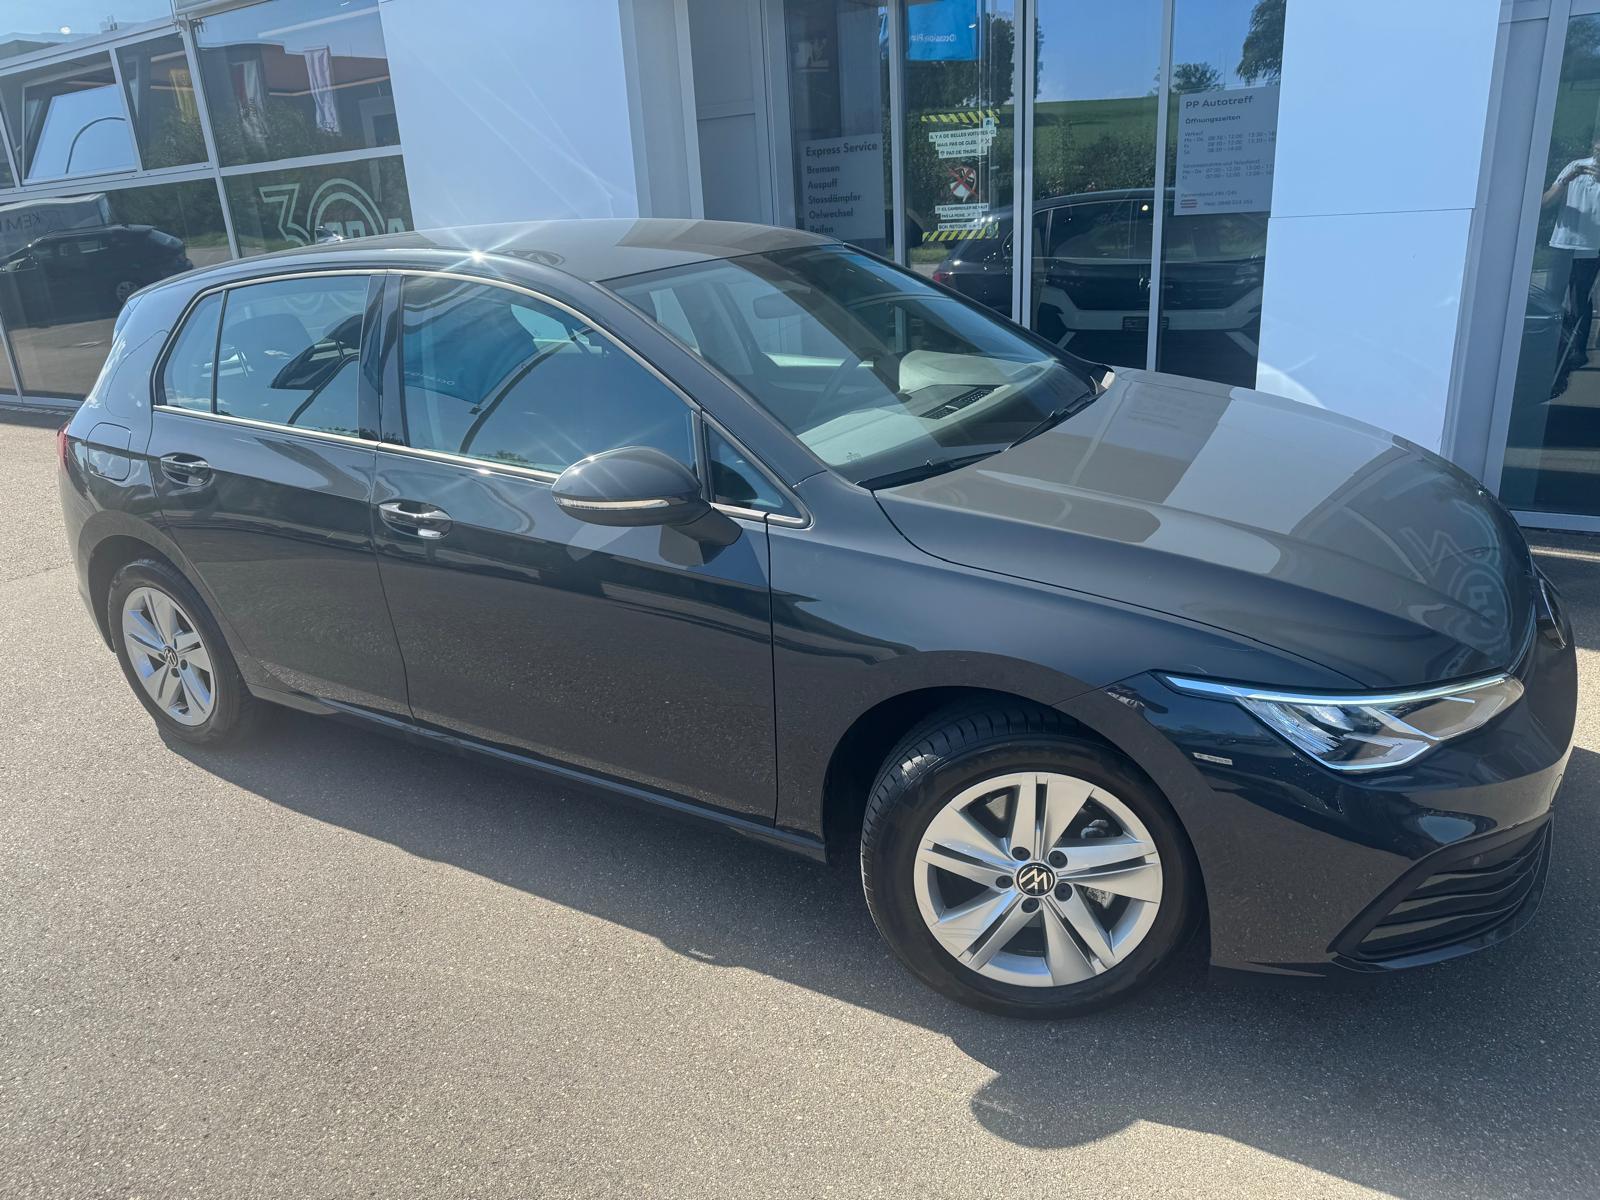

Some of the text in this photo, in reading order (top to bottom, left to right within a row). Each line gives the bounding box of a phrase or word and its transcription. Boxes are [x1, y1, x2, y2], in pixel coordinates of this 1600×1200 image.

[1185, 95, 1254, 109] PP Autotreff
[1185, 115, 1241, 125] Öffnungszeiten
[806, 141, 878, 158] Express Service
[807, 165, 840, 174] Bremsen
[807, 178, 838, 190] Auspuff
[807, 192, 862, 205] Stossdämpfer
[808, 208, 854, 219] Oelwechsel
[809, 224, 834, 233] Reifen
